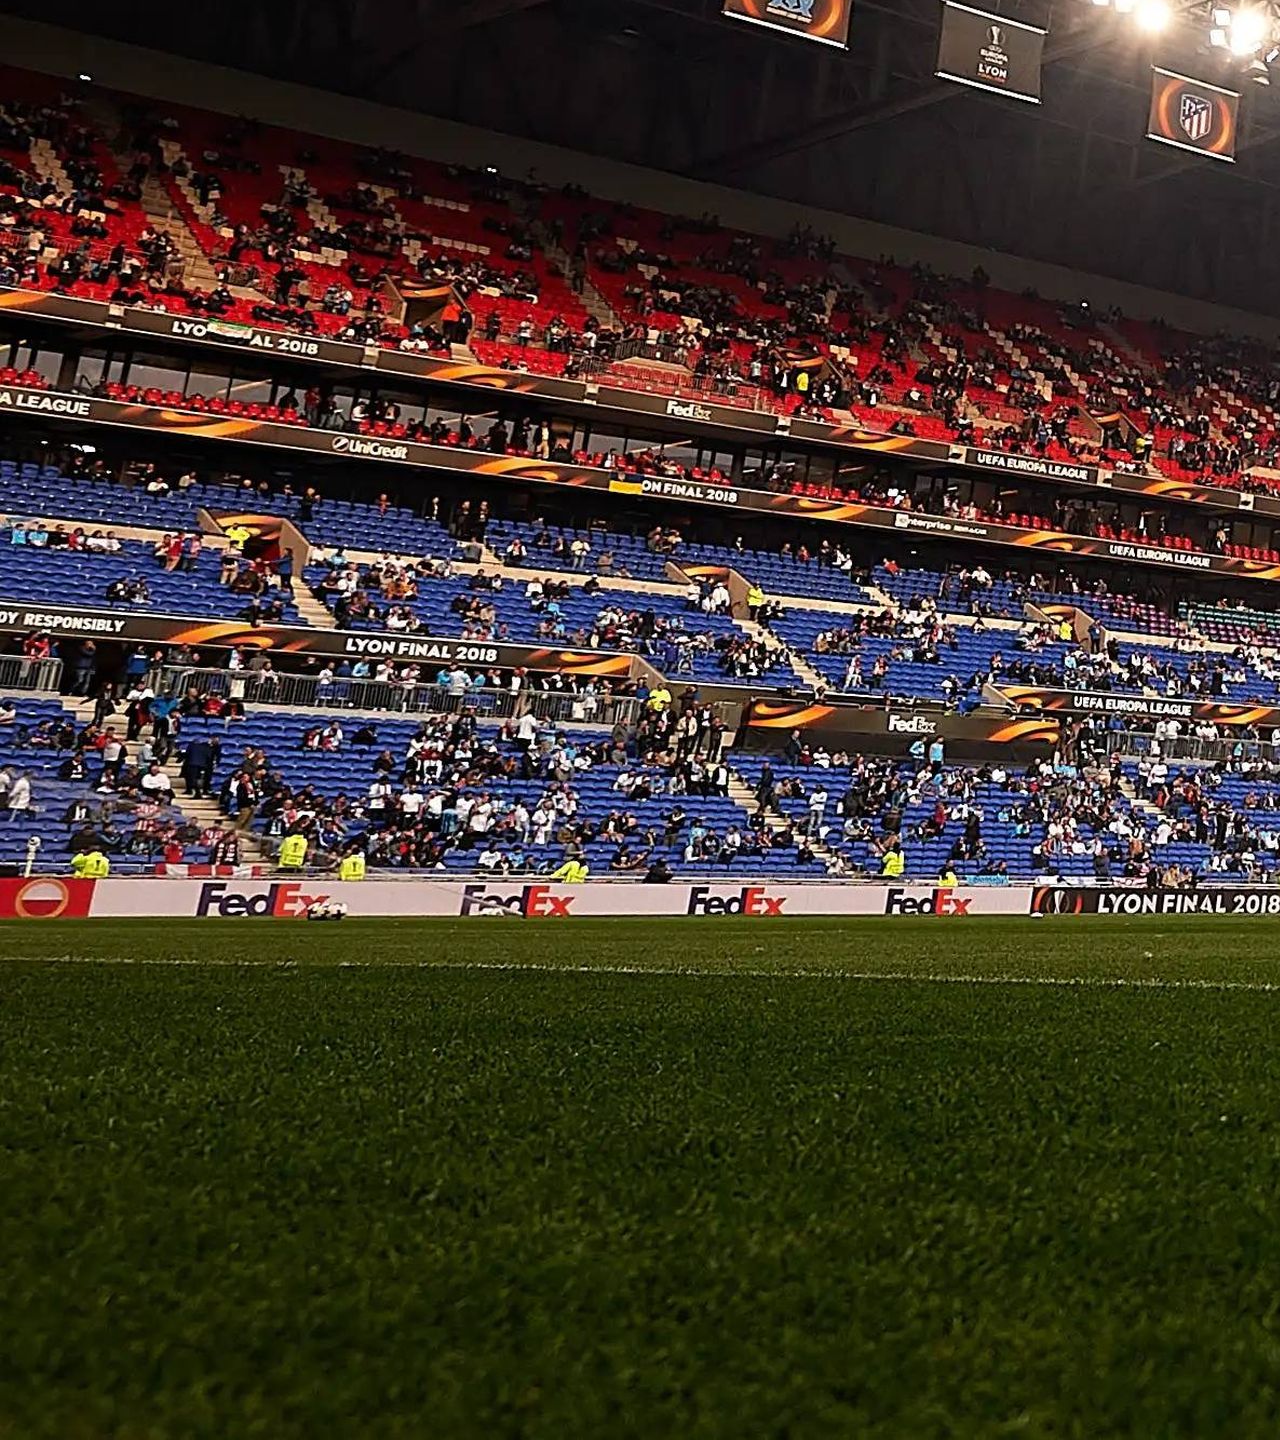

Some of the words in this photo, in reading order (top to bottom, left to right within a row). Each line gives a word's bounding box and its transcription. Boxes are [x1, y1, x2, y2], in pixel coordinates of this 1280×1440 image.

[978, 63, 1008, 79] LYON
[172, 320, 208, 337] LYO
[277, 338, 319, 355] 2018
[17, 392, 90, 416] LEAGUE
[666, 400, 712, 421] FedEx
[349, 439, 408, 460] UniCredit
[977, 452, 1006, 467] UEFA
[1006, 457, 1047, 474] EUROPA
[1048, 463, 1089, 480] LEAGUE
[663, 482, 704, 498] FINAL
[706, 488, 738, 503] 2018
[1109, 544, 1136, 557] UEFA
[1136, 548, 1173, 562] EUROPA
[1174, 553, 1211, 568] LEAGUE
[23, 613, 126, 633] RESPONSIBLY
[346, 638, 396, 654] LYON
[397, 642, 452, 659] FINAL
[455, 646, 498, 662] 2018
[1074, 695, 1103, 709] UEFA
[1105, 698, 1149, 713] EUROPA
[1150, 702, 1192, 716] LEAGUE
[888, 714, 937, 734] FedEx
[460, 884, 576, 918] FedEx
[688, 886, 787, 916] FedEx
[885, 888, 973, 916] FedEx
[1097, 893, 1158, 914] LYON
[1162, 894, 1227, 914] FINAL
